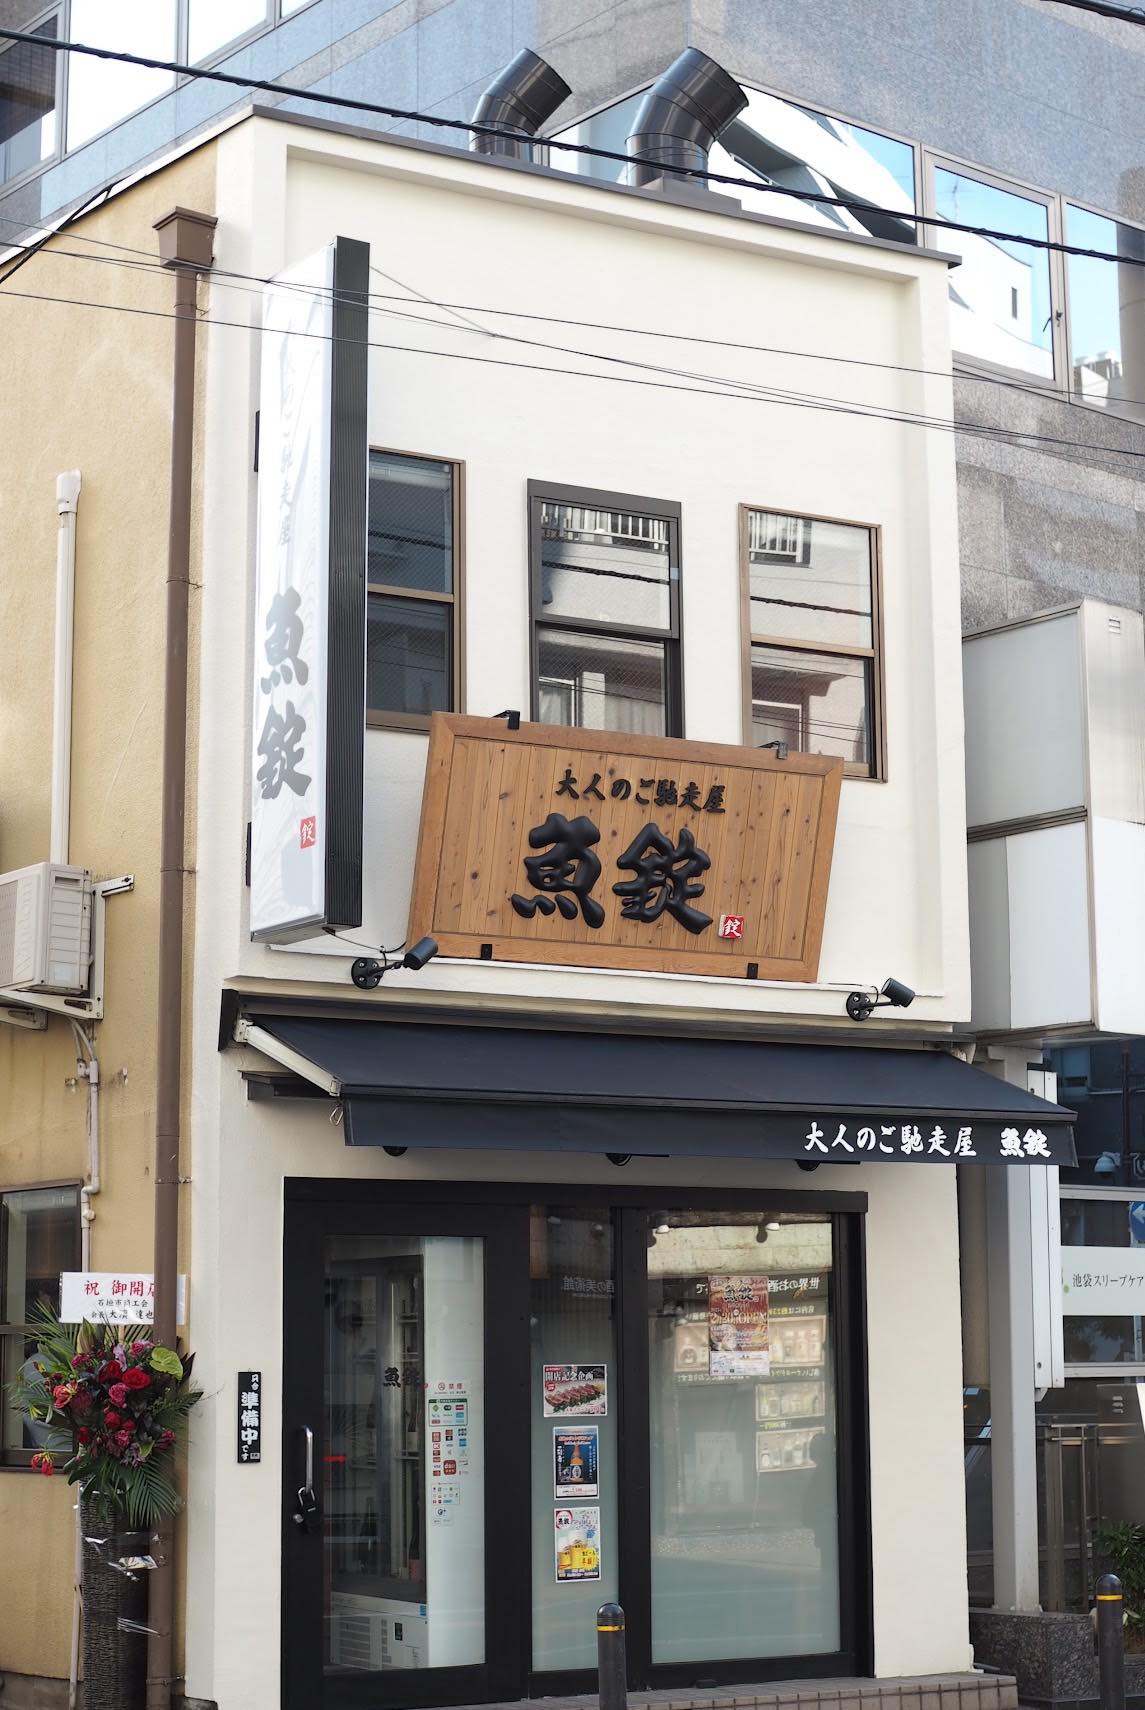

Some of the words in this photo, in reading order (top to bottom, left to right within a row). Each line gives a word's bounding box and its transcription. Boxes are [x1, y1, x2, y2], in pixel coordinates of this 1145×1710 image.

[256, 586, 312, 799] 魚錠
[555, 769, 727, 814] 大人のご馳走屋
[510, 812, 714, 935] 魚錠
[804, 1121, 977, 1157] 大人のご馳走屋
[1000, 1127, 1052, 1158] 魚錠
[84, 1279, 100, 1296] 祝
[1072, 1273, 1144, 1288] 池袋スリープケア
[241, 1391, 259, 1445] 準備中
